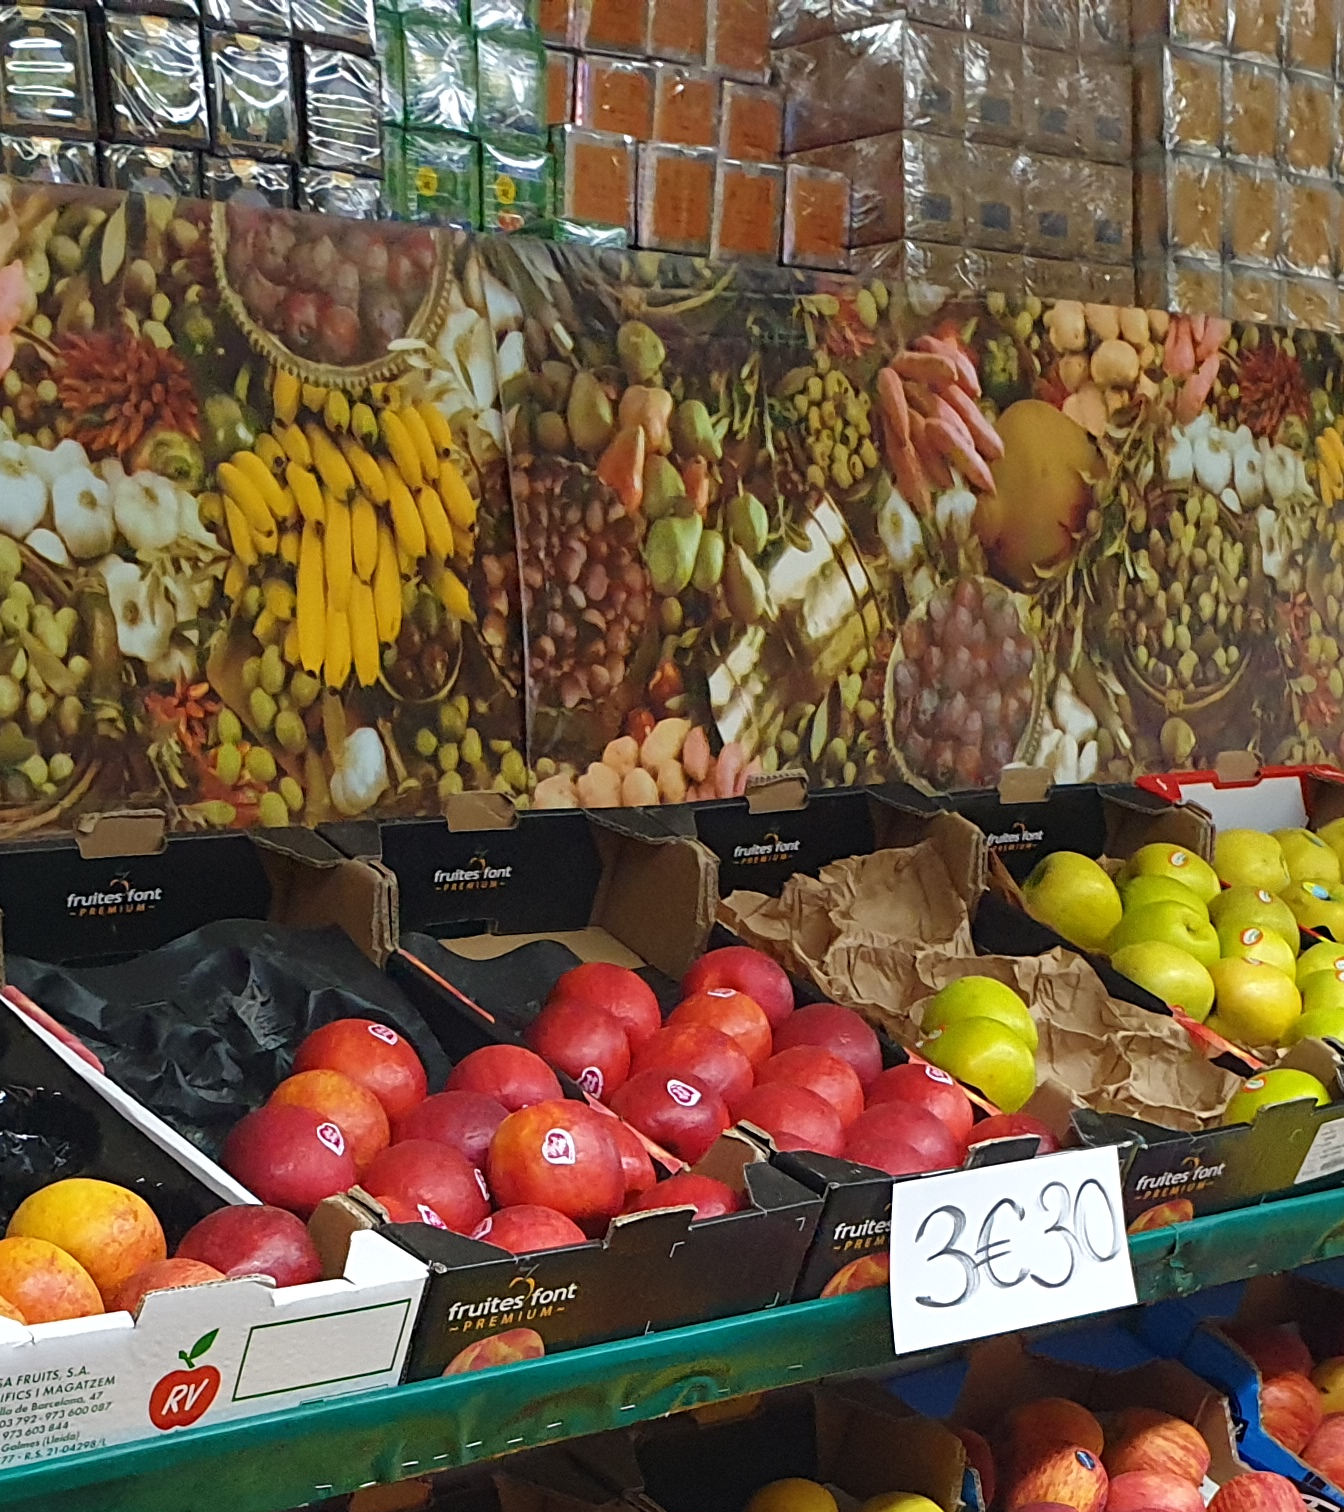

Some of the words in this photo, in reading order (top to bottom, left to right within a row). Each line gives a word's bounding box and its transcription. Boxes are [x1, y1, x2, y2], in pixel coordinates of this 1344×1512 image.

[483, 864, 512, 880] font
[67, 892, 123, 908] fruites
[126, 887, 163, 902] font
[1136, 1172, 1190, 1192] fruites
[1192, 1162, 1227, 1183] font
[915, 1178, 1120, 1308] 3€30
[448, 1293, 525, 1321] fruites
[531, 1282, 578, 1306] font
[462, 1305, 553, 1332] PREMIUM
[16, 1369, 63, 1387] FRUITS,
[66, 1366, 90, 1379] S.A.
[42, 1375, 116, 1397] MAGATZEM
[160, 1378, 210, 1416] RV
[3, 1427, 24, 1440] 973
